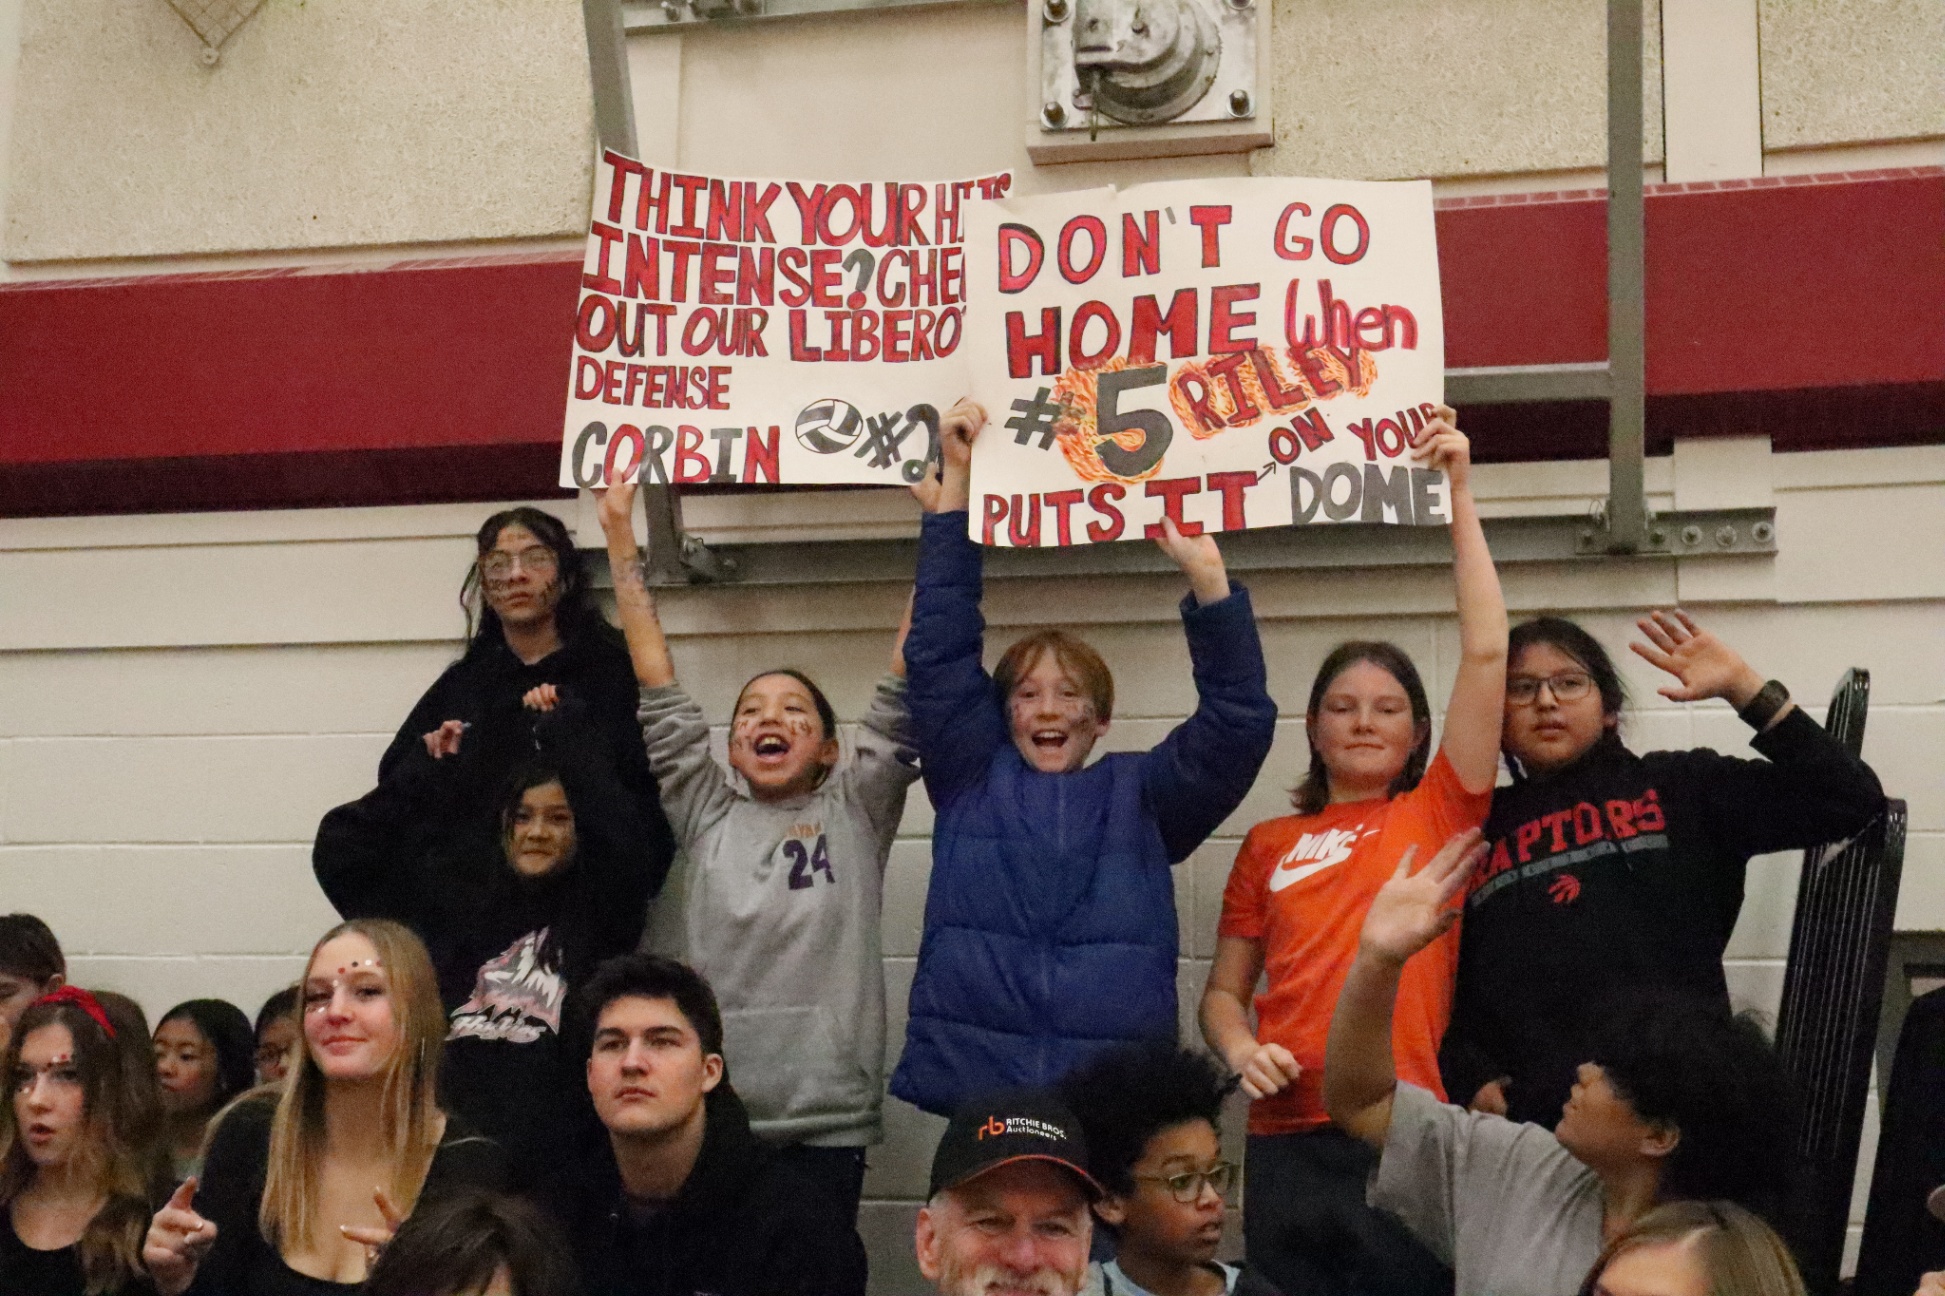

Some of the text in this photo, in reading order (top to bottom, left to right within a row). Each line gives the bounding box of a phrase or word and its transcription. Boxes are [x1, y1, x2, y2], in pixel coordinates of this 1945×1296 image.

[603, 150, 781, 244] THINK
[786, 182, 930, 247] YOUR
[582, 220, 966, 310] INTENSE? CHE
[998, 204, 1232, 294] DON'T
[1274, 202, 1370, 265] GO
[575, 294, 678, 357] OUT
[680, 307, 769, 357] OUR
[1005, 283, 1261, 378] HOME
[574, 355, 732, 410] DEFENSE
[1176, 346, 1363, 432] RILEY
[571, 421, 780, 487] CORBIN
[1268, 407, 1334, 465] ON
[982, 470, 1258, 548] PUTS IT
[1289, 463, 1444, 525] DOME
[782, 834, 836, 891] 24
[977, 1115, 1005, 1141] rb
[1006, 1118, 1040, 1129] RITCHIE
